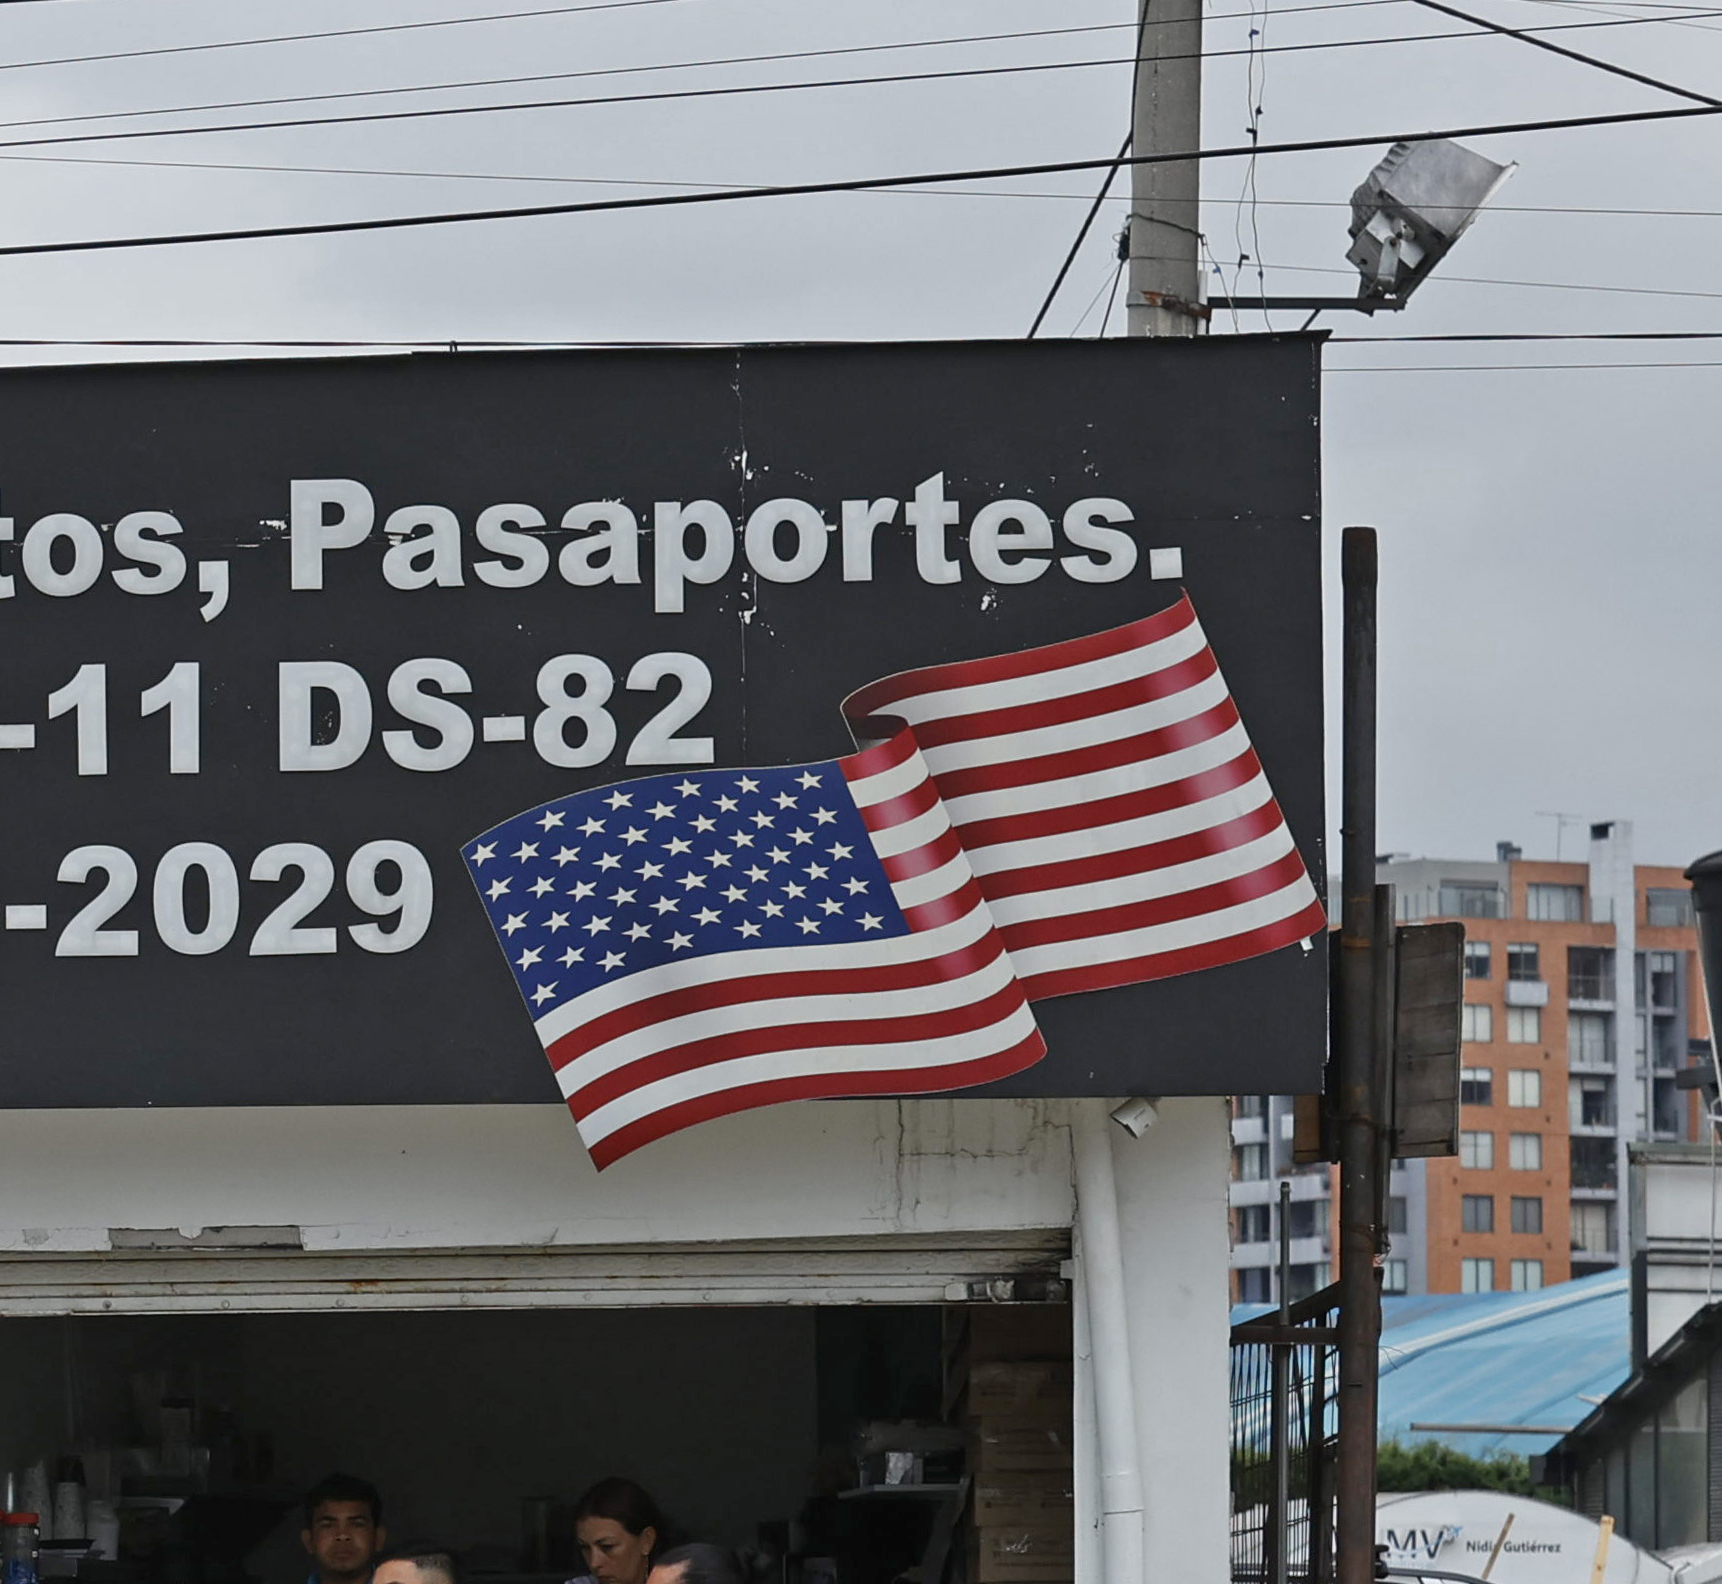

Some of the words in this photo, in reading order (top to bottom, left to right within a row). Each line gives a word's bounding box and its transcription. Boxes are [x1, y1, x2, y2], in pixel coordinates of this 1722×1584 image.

[280, 470, 1184, 613] Pasaportes.
[278, 650, 716, 772] DS-82
[1466, 1540, 1501, 1553] Nidi
[1504, 1539, 1562, 1554] Gutiérrez
